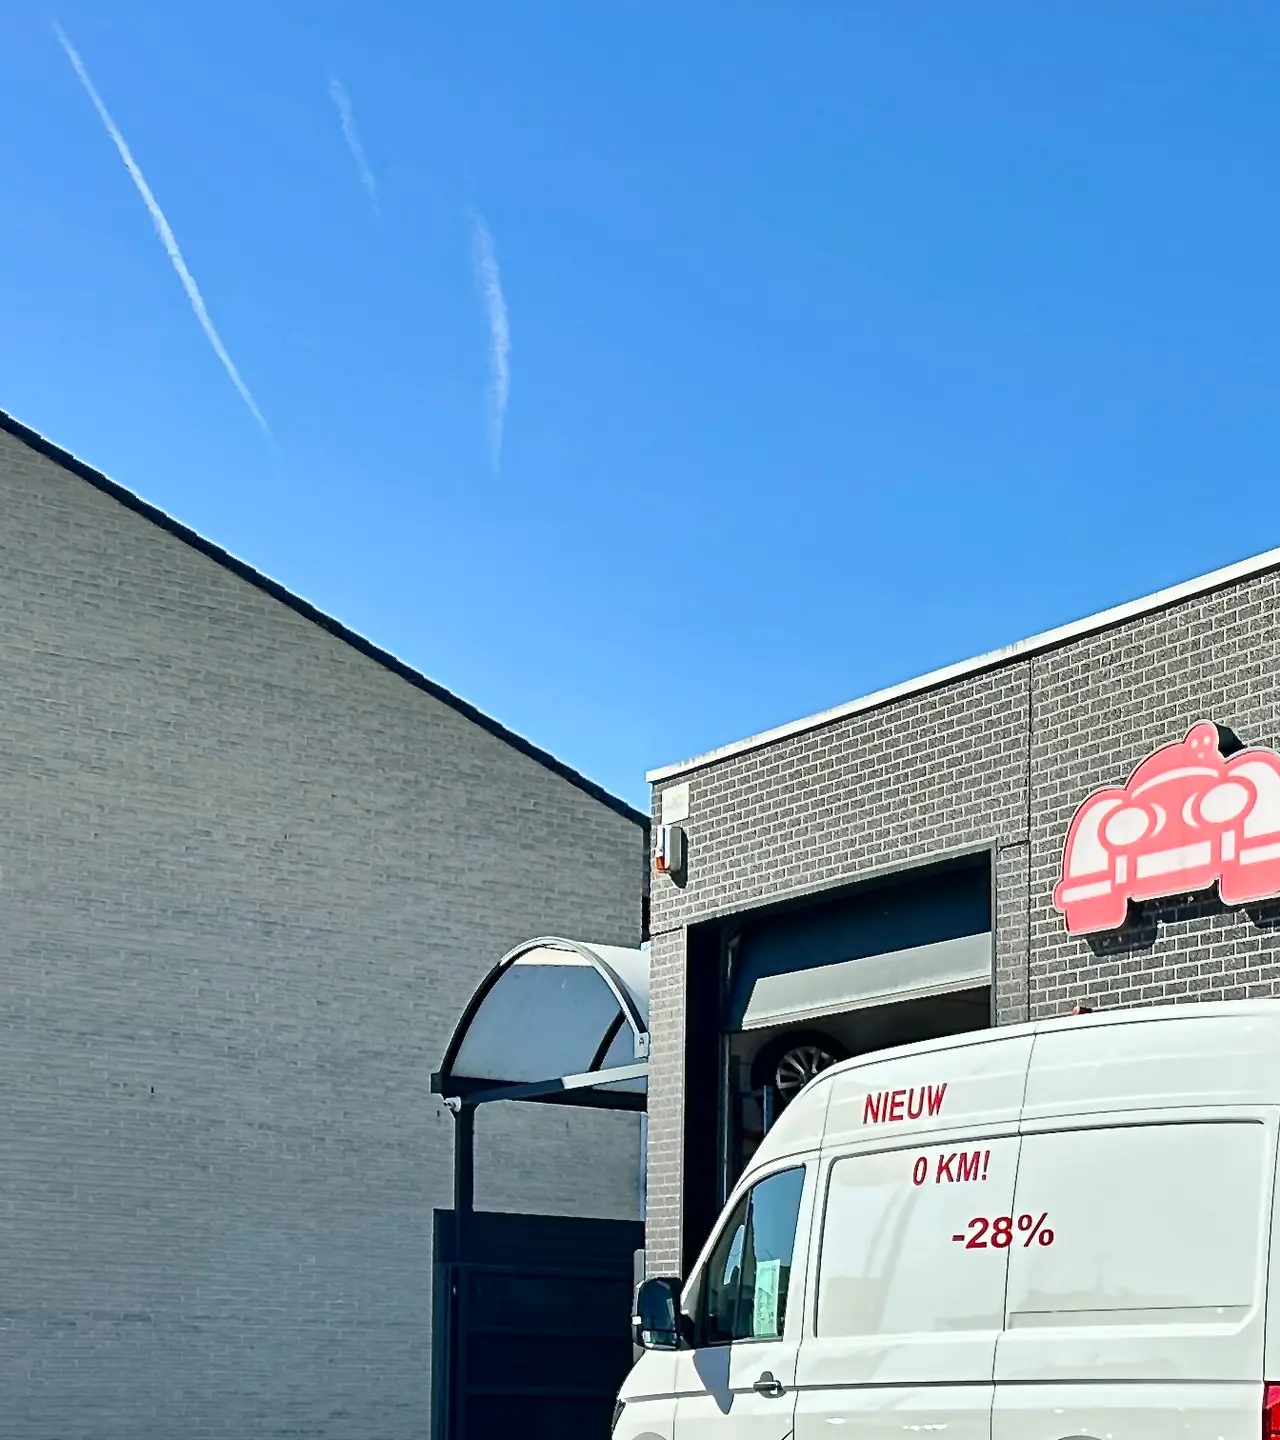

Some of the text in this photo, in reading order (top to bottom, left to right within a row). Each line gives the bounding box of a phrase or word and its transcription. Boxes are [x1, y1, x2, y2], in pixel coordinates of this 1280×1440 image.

[862, 1082, 948, 1125] NIEUW
[912, 1149, 991, 1187] 0 KM!
[951, 1212, 1055, 1250] -28%
